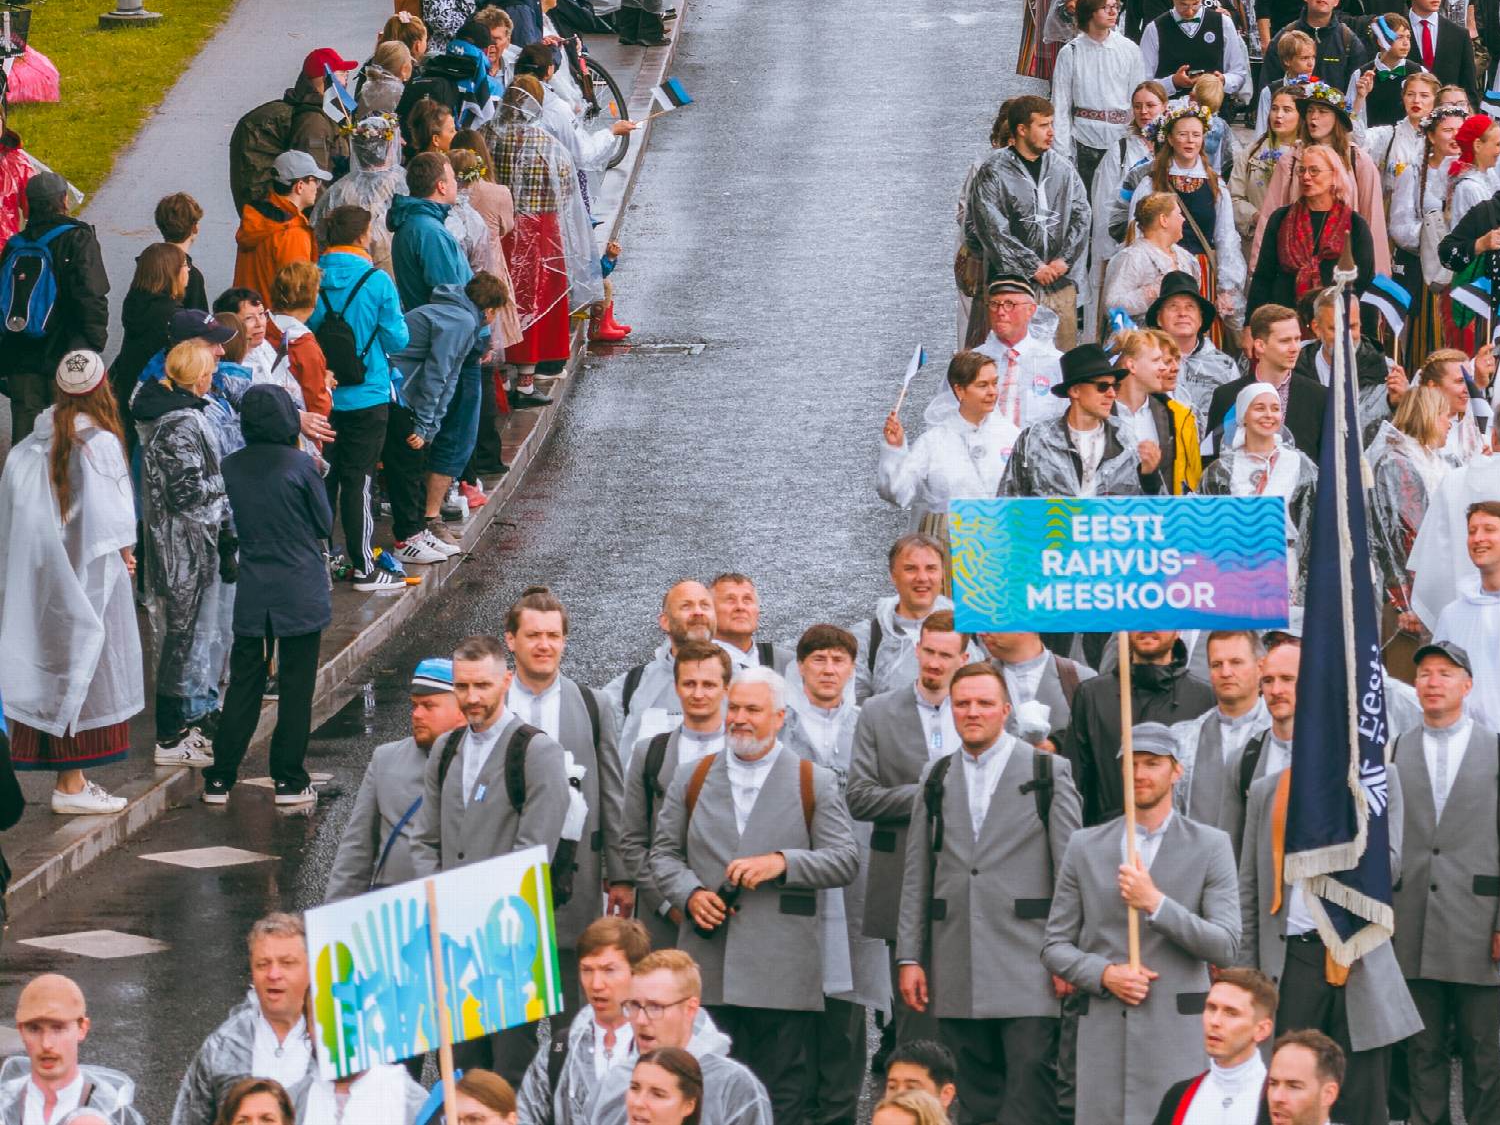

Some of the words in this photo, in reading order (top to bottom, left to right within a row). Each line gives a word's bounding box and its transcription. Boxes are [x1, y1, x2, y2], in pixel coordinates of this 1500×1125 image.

[1071, 514, 1165, 542] EESTI
[1041, 549, 1197, 577] RAHVUS-
[1026, 582, 1216, 612] MEESKOOR
